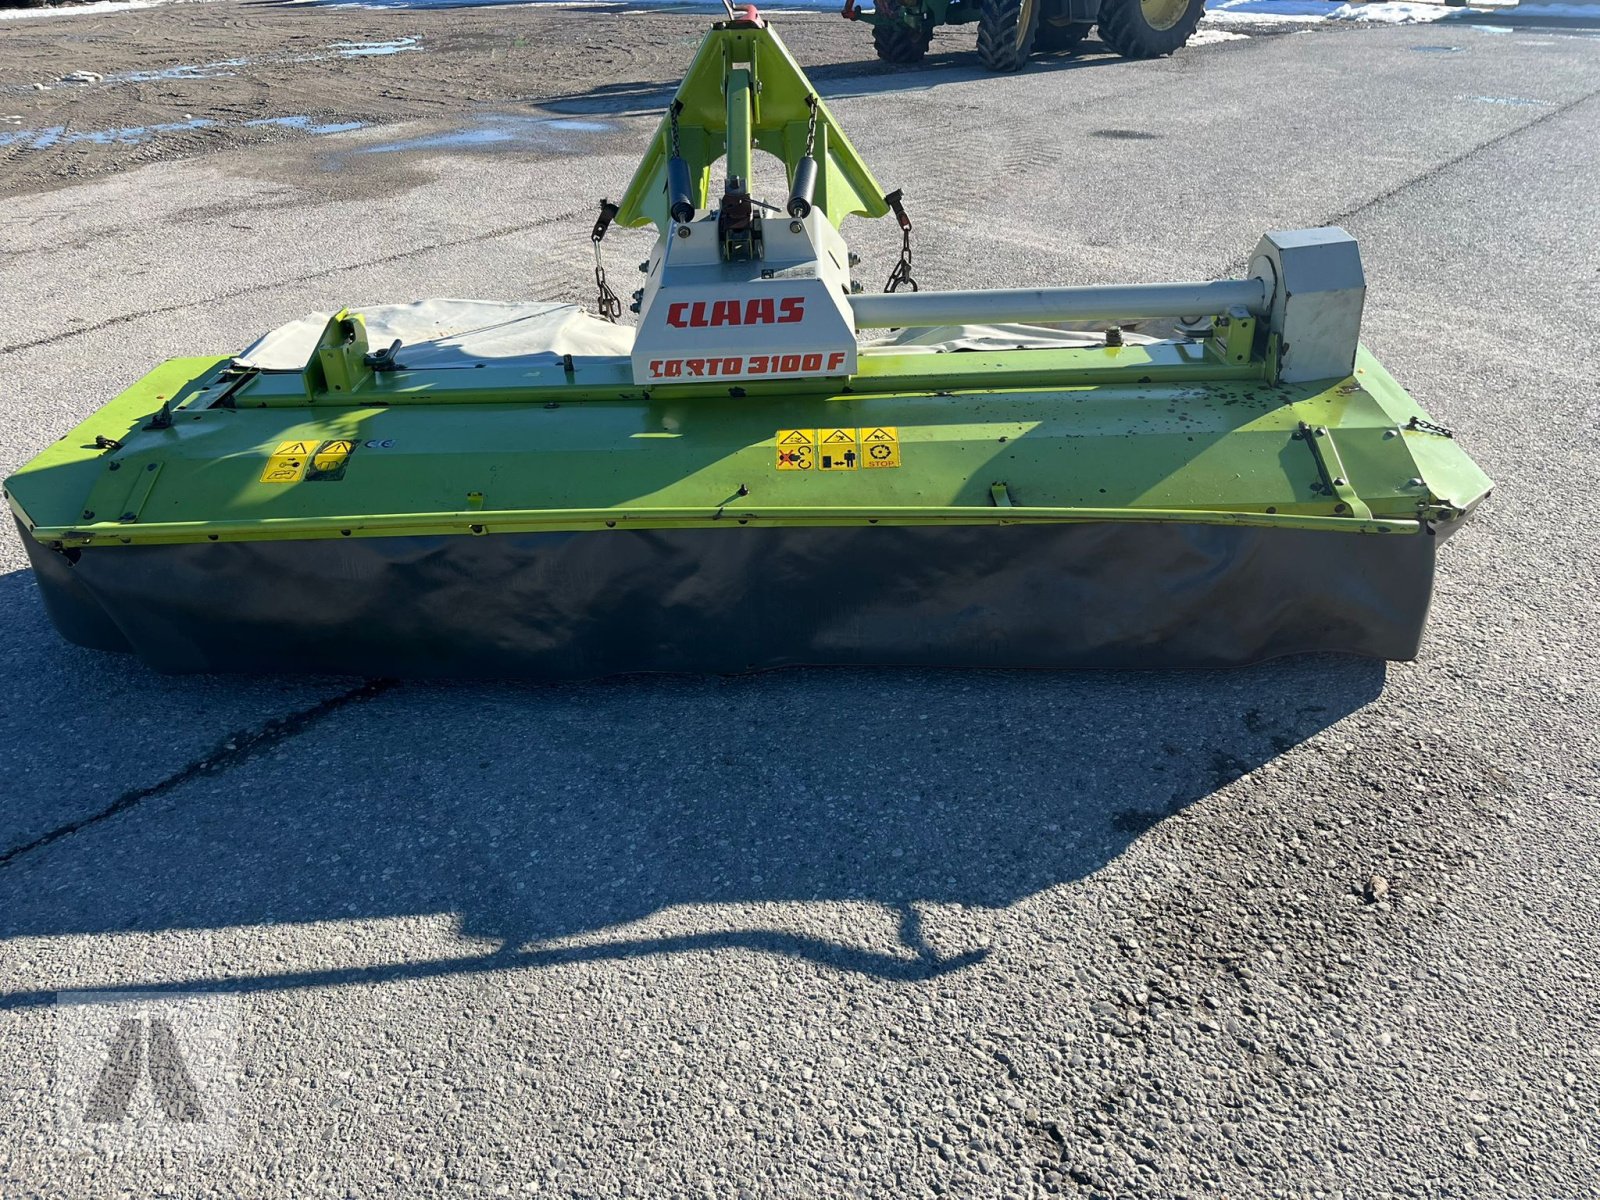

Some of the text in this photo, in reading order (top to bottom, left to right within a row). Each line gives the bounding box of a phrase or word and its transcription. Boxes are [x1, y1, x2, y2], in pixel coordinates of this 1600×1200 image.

[666, 297, 805, 328] CLAAS
[748, 354, 823, 374] 3100
[827, 352, 846, 370] F
